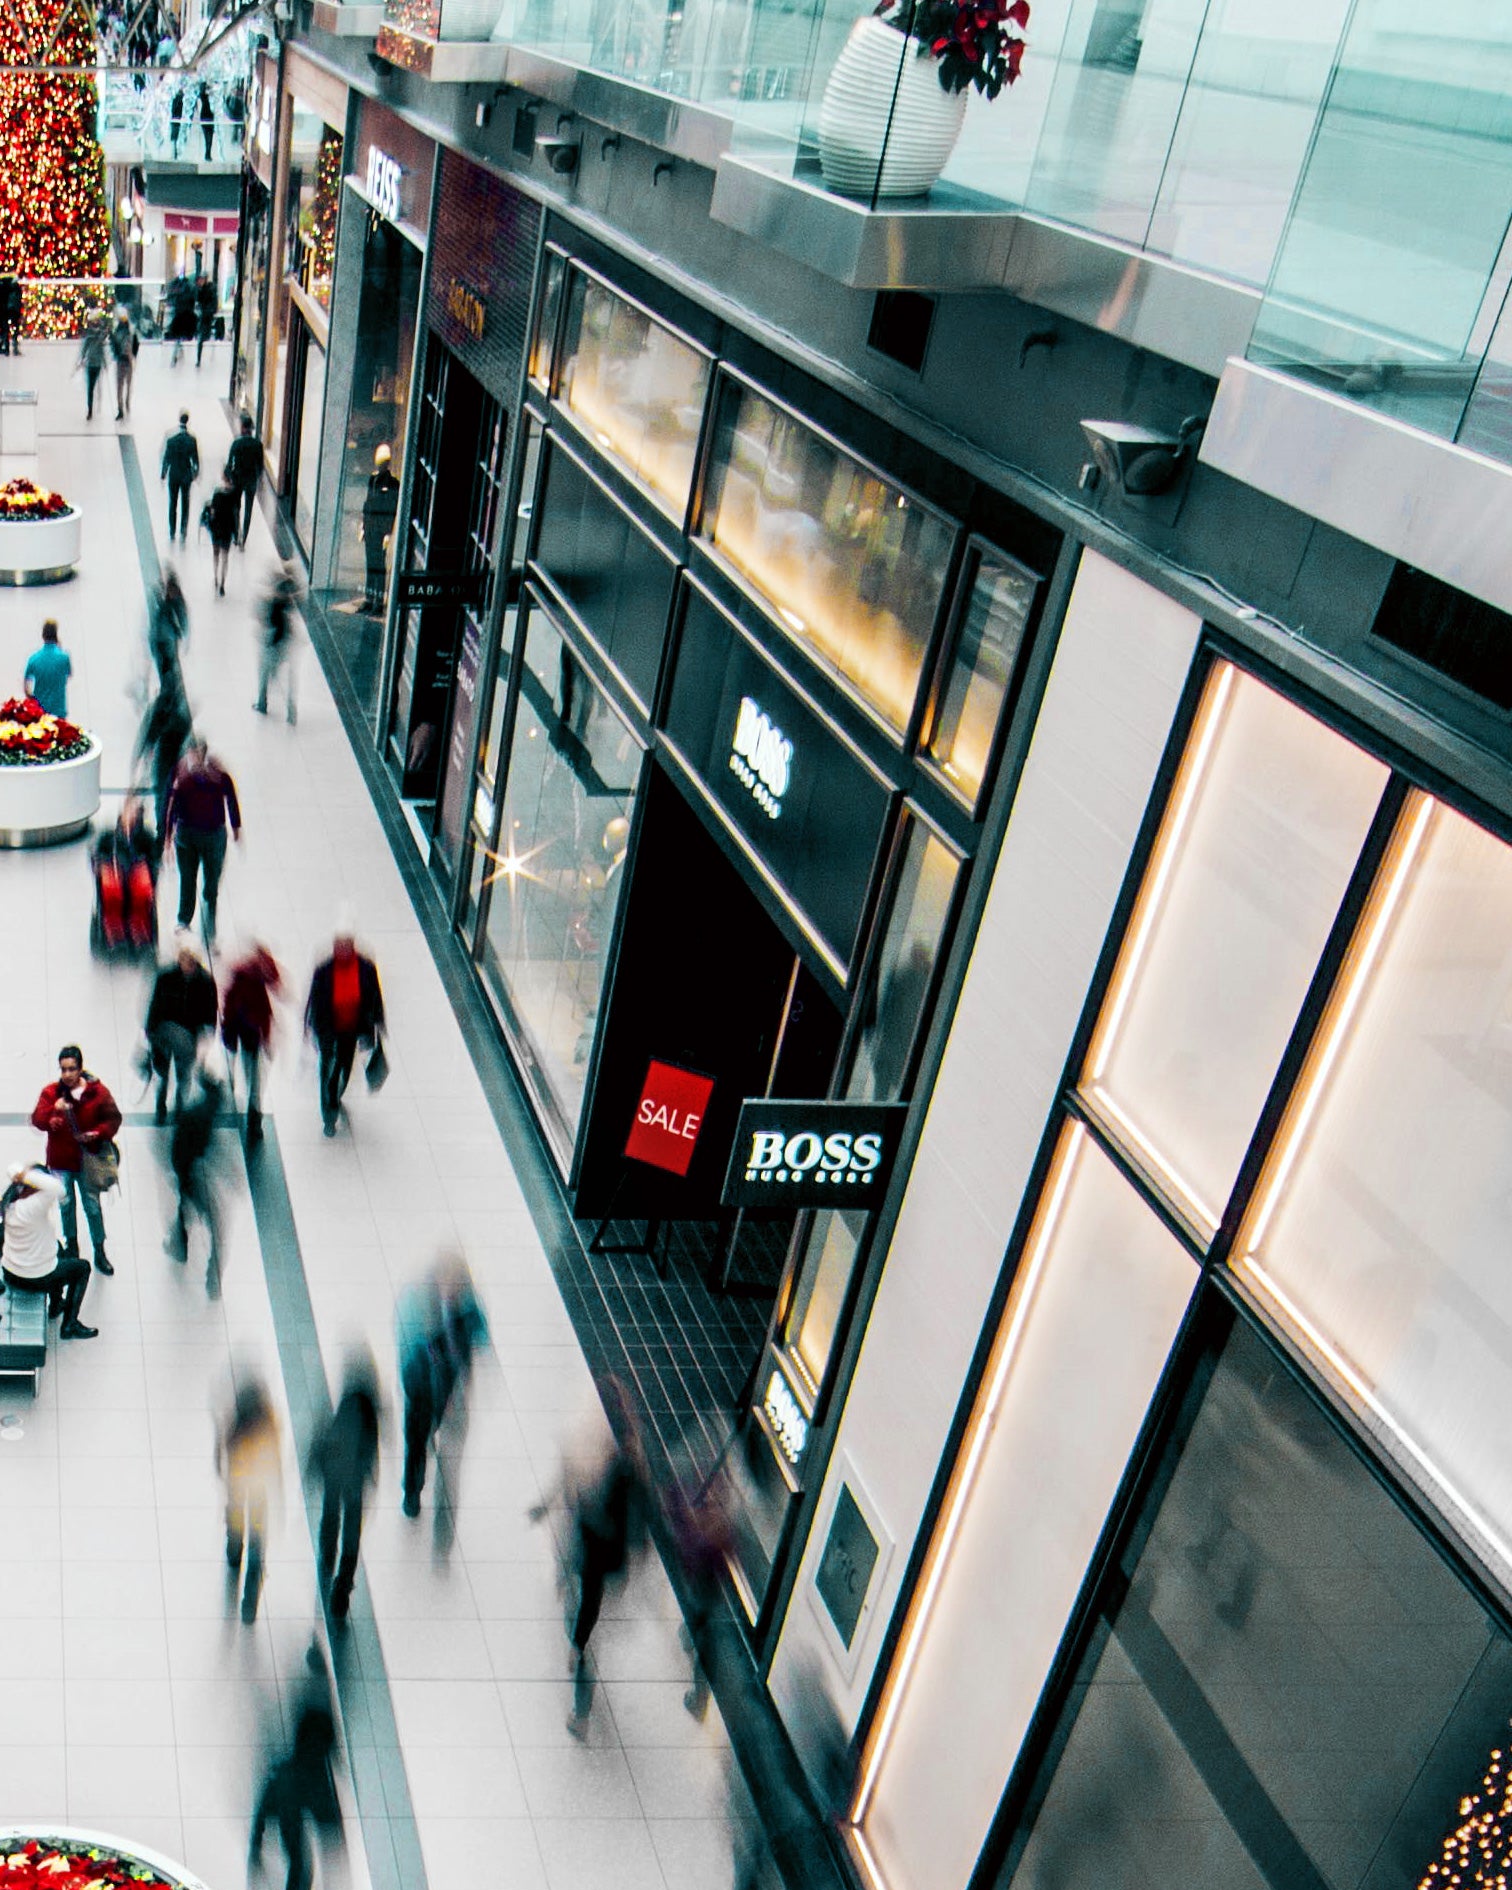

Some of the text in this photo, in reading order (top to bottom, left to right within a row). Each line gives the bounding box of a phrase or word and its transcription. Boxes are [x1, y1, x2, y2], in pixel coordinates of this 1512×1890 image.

[638, 1099, 700, 1140] SALE
[746, 1130, 882, 1172] BOSS
[744, 1169, 804, 1183] HUGO
